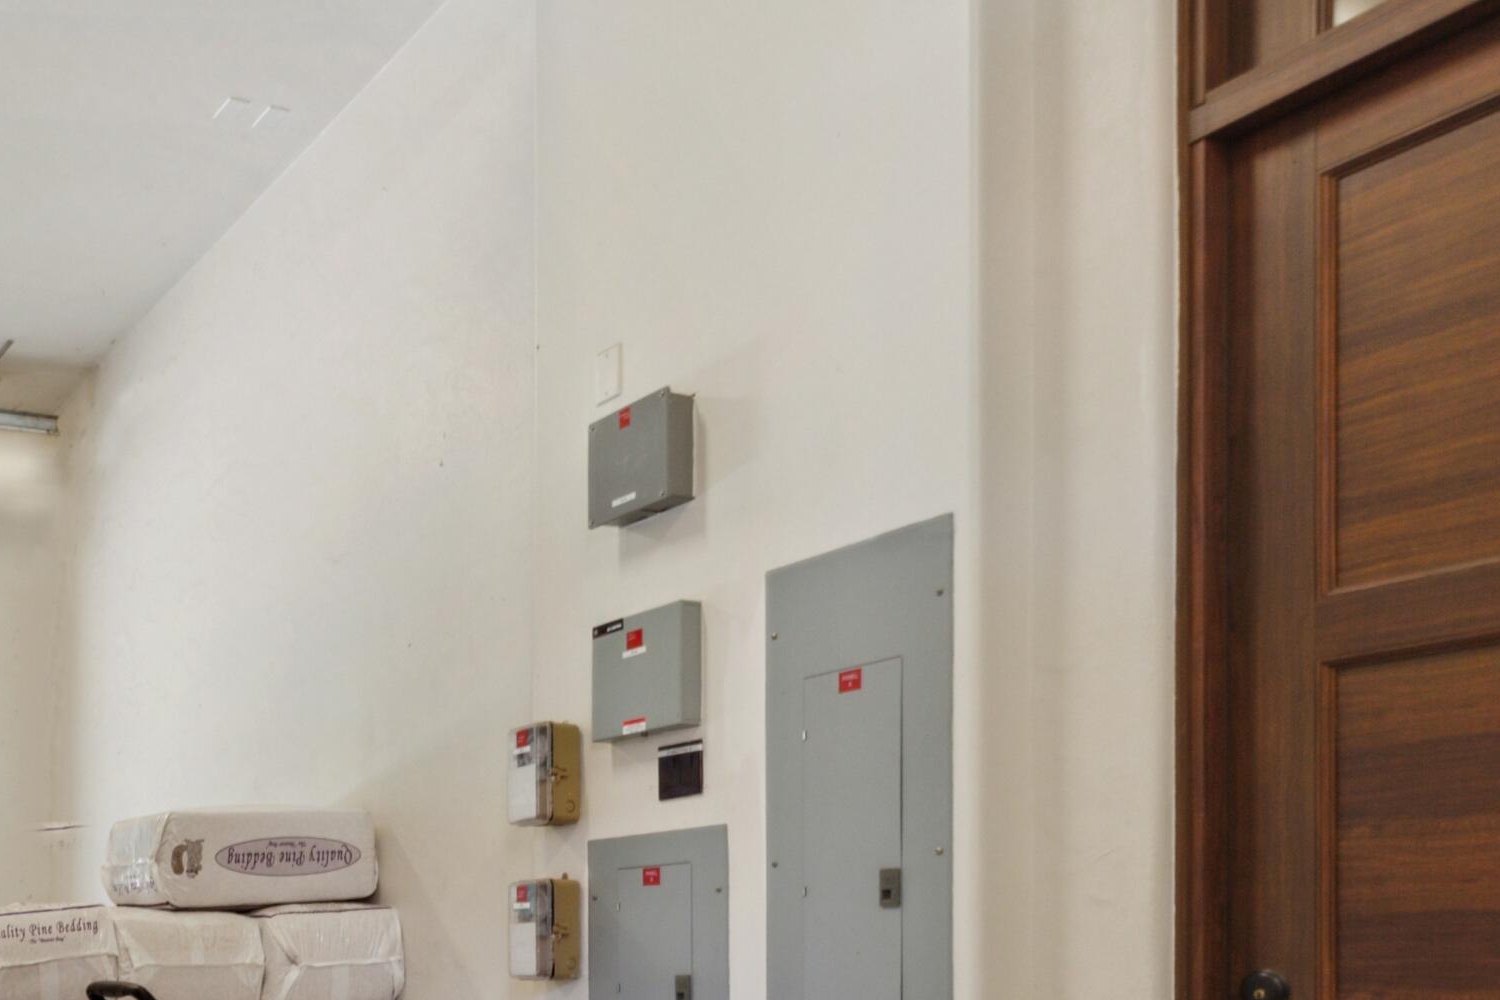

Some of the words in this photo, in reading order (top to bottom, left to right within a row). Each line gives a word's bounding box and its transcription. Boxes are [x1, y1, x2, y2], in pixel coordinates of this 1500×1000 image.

[227, 846, 276, 871] Bedding
[279, 850, 305, 867] Pine
[309, 843, 353, 868] Quality
[28, 922, 53, 937] Pine
[56, 917, 99, 935] Bedding
